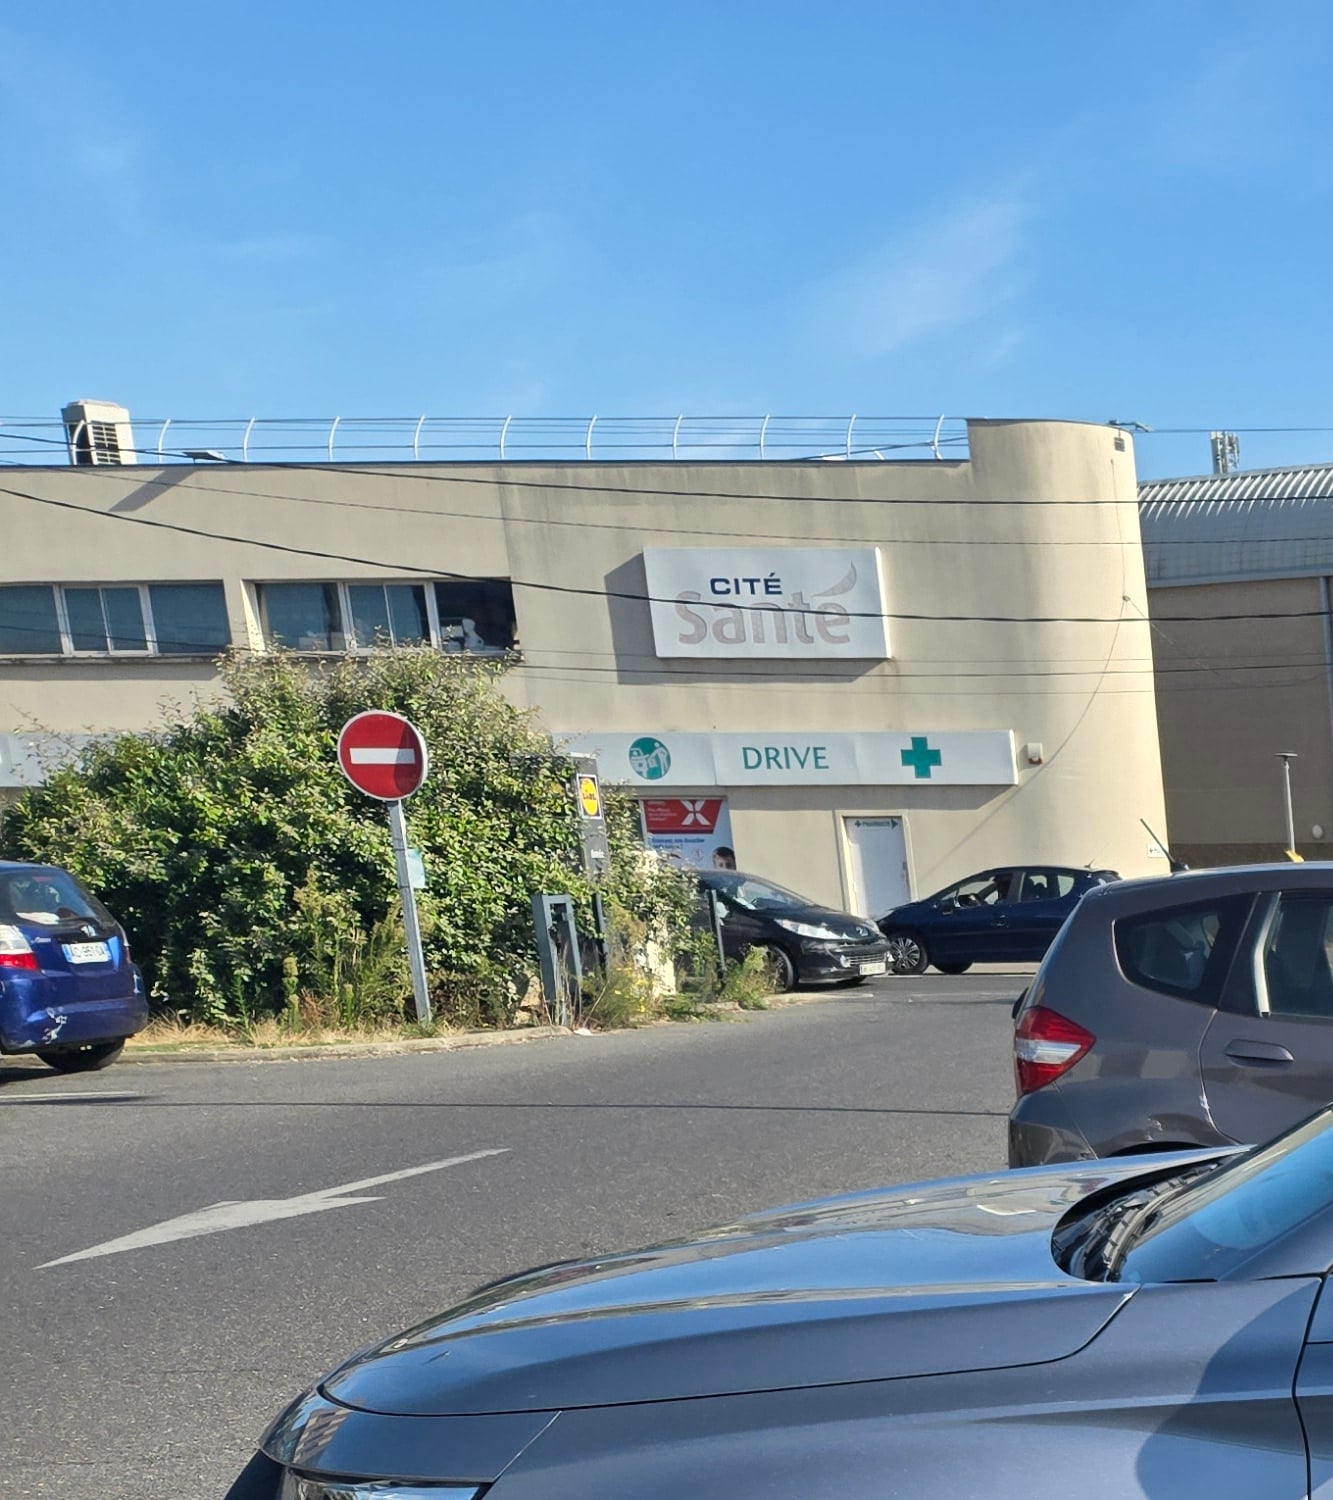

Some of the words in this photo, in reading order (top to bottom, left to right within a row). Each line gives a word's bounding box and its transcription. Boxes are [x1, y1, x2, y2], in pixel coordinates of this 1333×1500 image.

[710, 572, 783, 595] CITÉ
[675, 560, 857, 645] Santé
[742, 747, 829, 769] DRIVE
